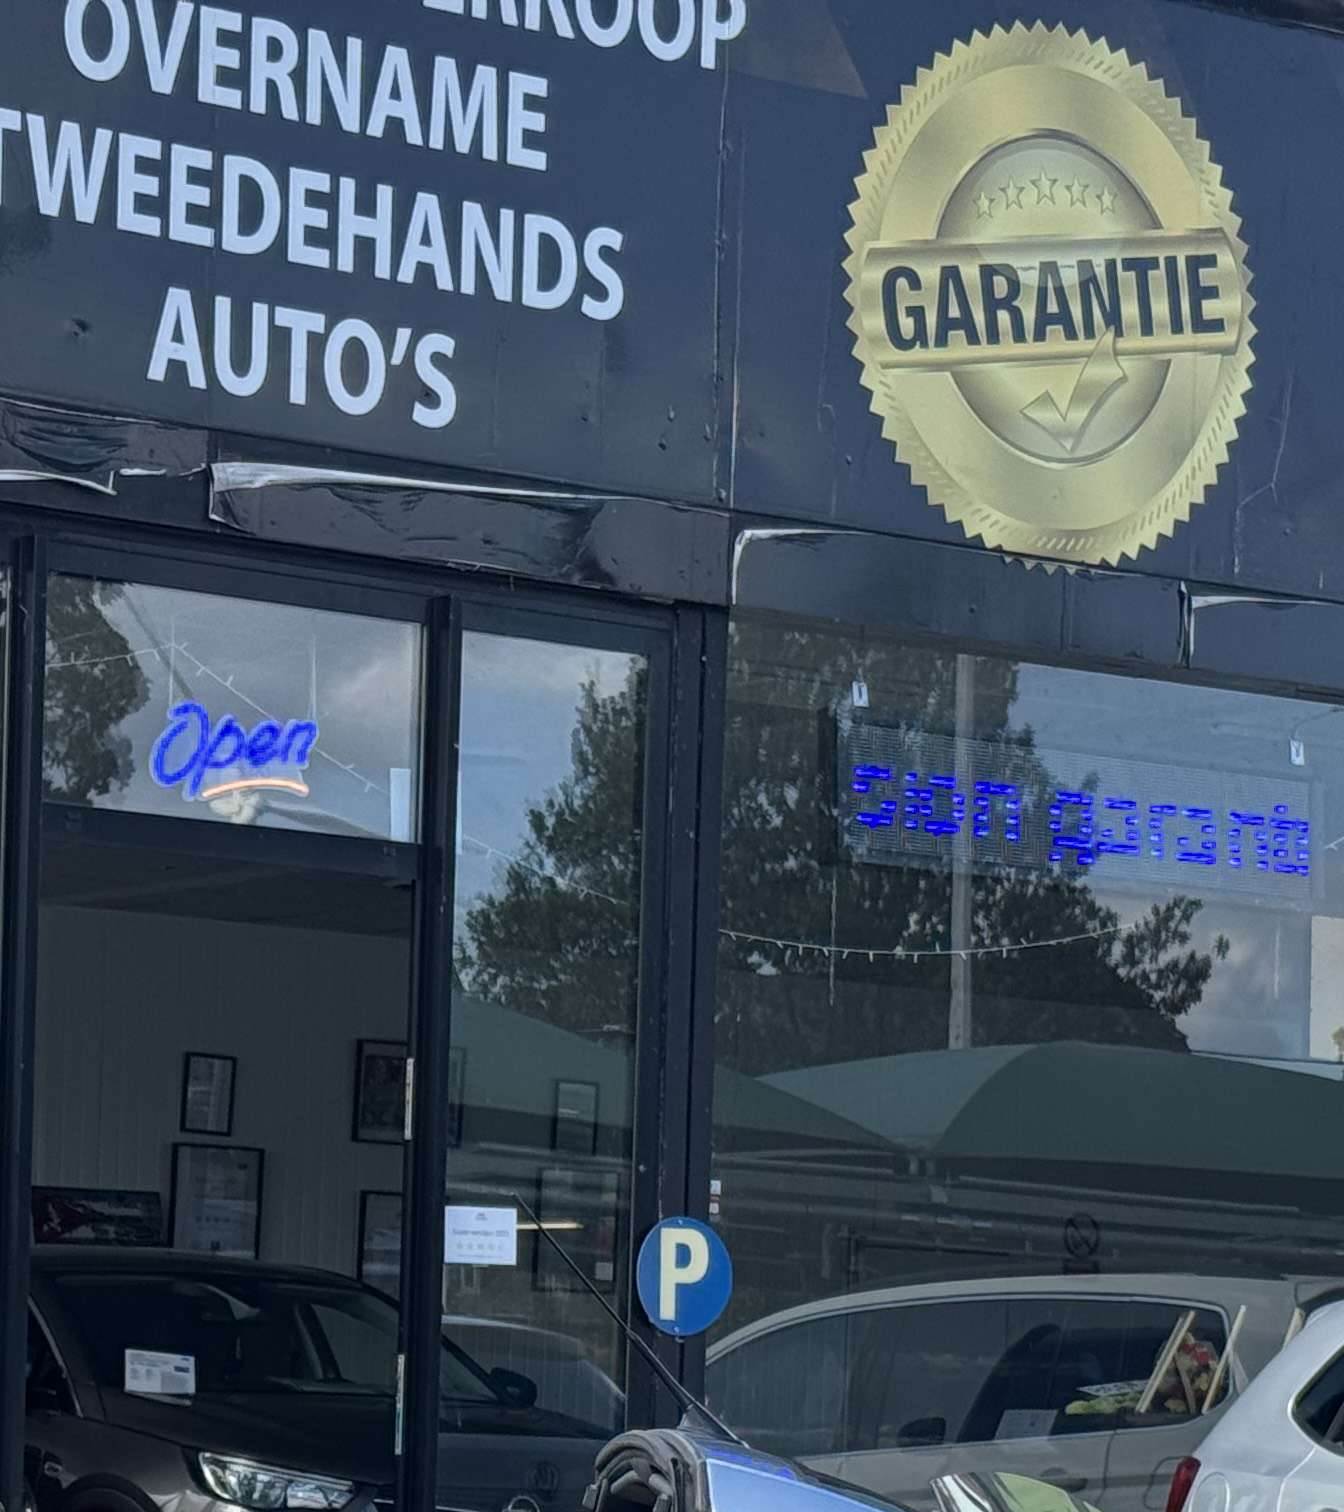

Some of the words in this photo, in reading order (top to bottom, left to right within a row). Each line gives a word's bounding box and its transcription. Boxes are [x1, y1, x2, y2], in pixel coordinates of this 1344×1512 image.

[64, 0, 549, 171] OVERNAME
[881, 254, 1225, 351] GARANTIE
[147, 287, 457, 428] AUTO'S
[152, 701, 318, 800] Open
[659, 1227, 709, 1321] P
